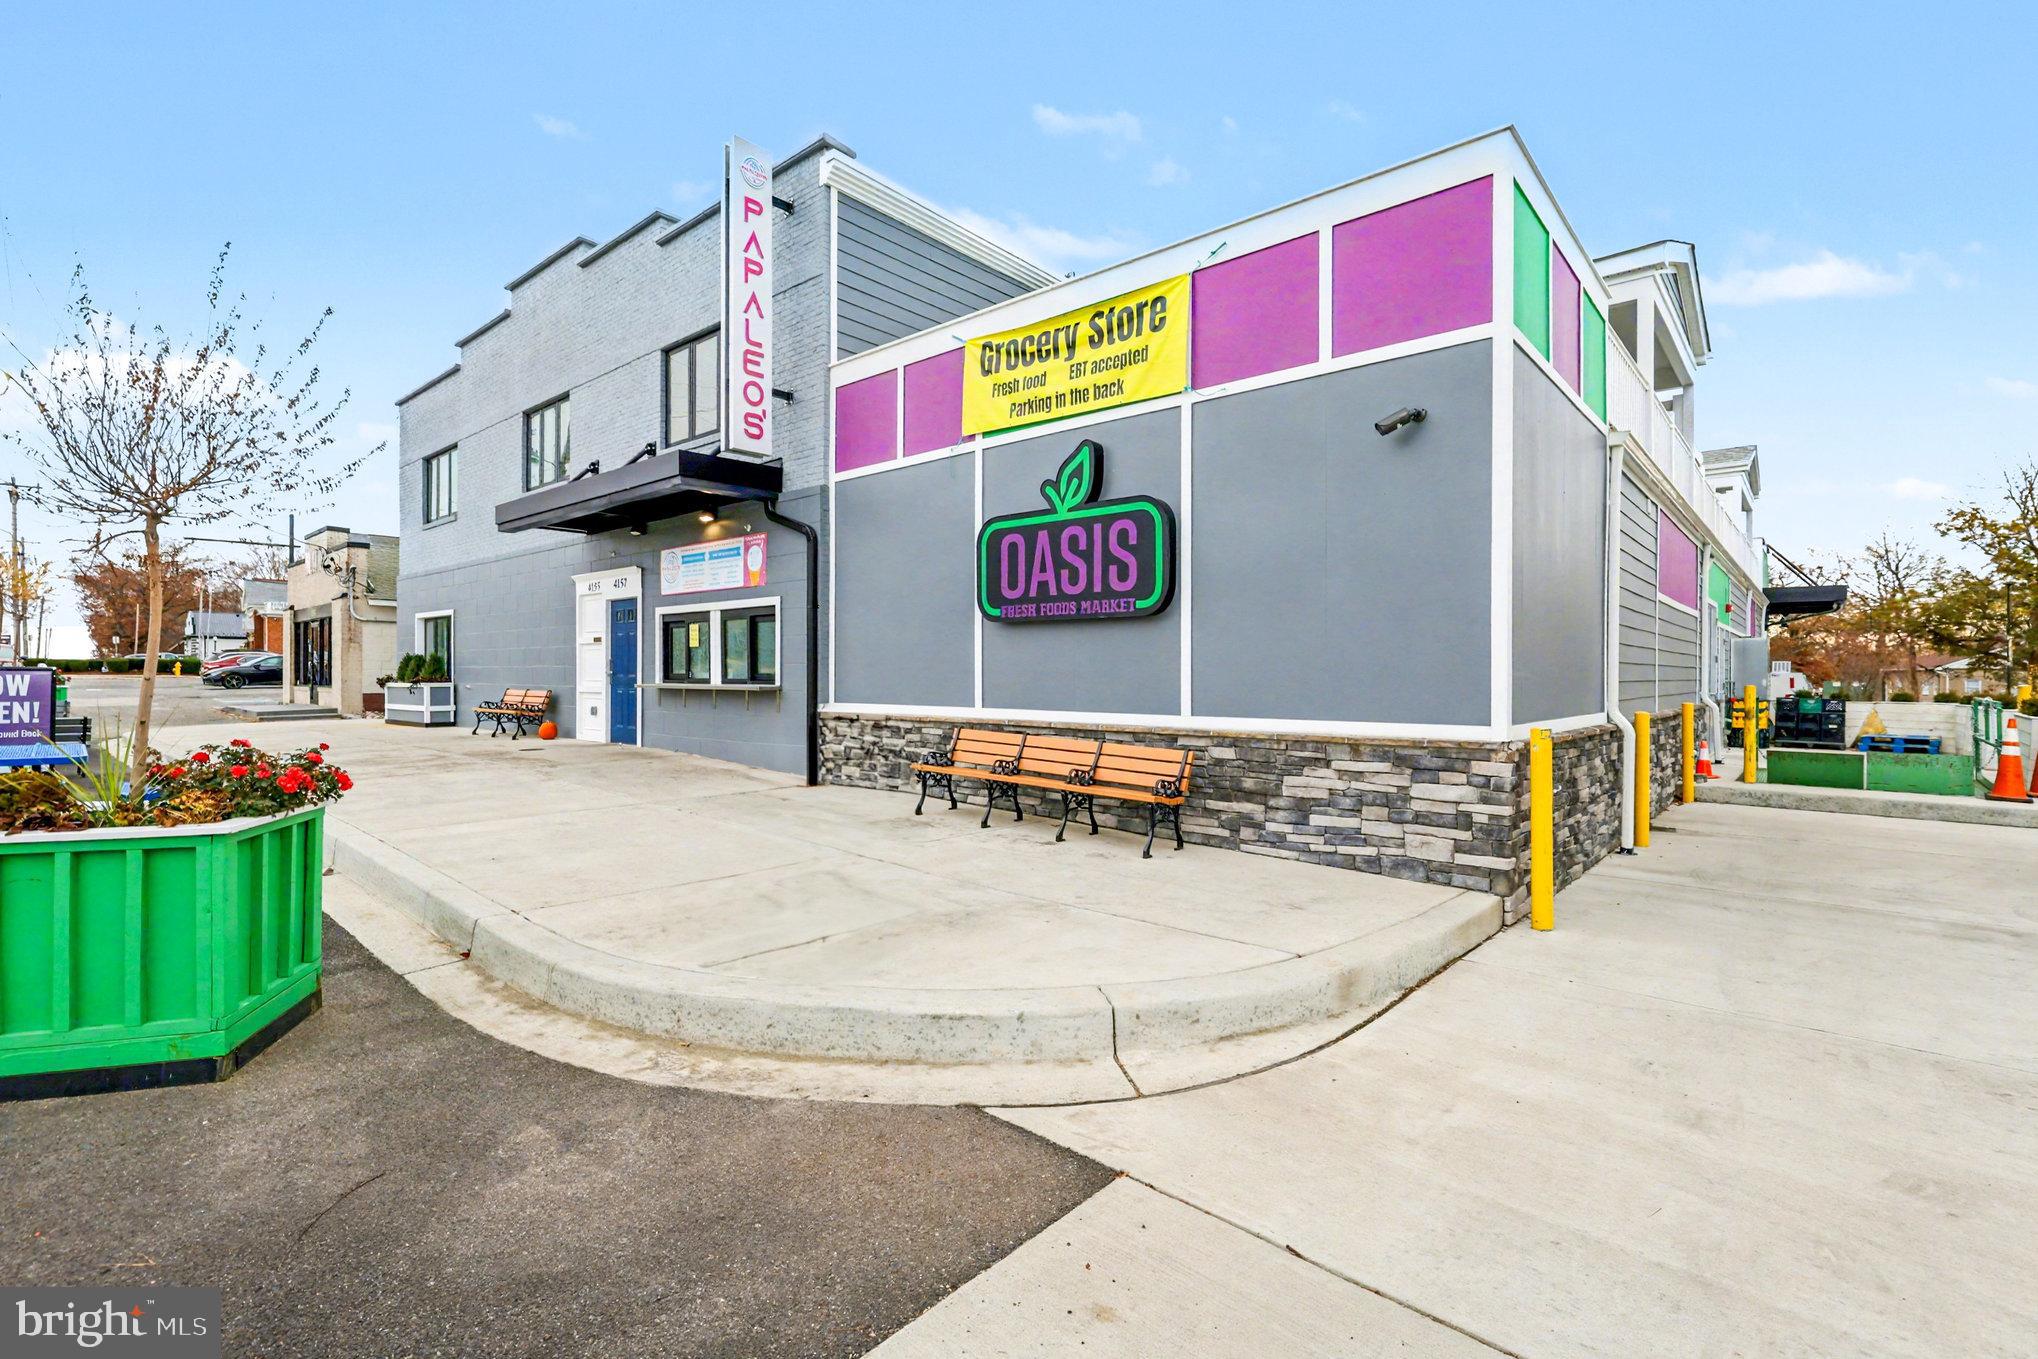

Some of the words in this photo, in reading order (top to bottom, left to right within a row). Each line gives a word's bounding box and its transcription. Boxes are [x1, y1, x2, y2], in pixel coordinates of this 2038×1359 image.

[980, 321, 1080, 377] Grocery
[1088, 295, 1167, 350] Store
[992, 376, 1020, 398] Fresh
[1022, 371, 1047, 392] food
[1069, 363, 1088, 380] EBT
[1091, 345, 1148, 376] accepted
[1009, 393, 1052, 418] Parking
[1055, 392, 1067, 408] in
[1070, 388, 1090, 405] the
[1093, 378, 1124, 401] back
[1000, 518, 1137, 600] OASIS
[613, 578, 628, 589] 4157
[1001, 603, 1037, 618] FRESH
[1040, 601, 1076, 616] FOODS
[1080, 598, 1136, 614] MARKET
[0, 674, 31, 697] W
